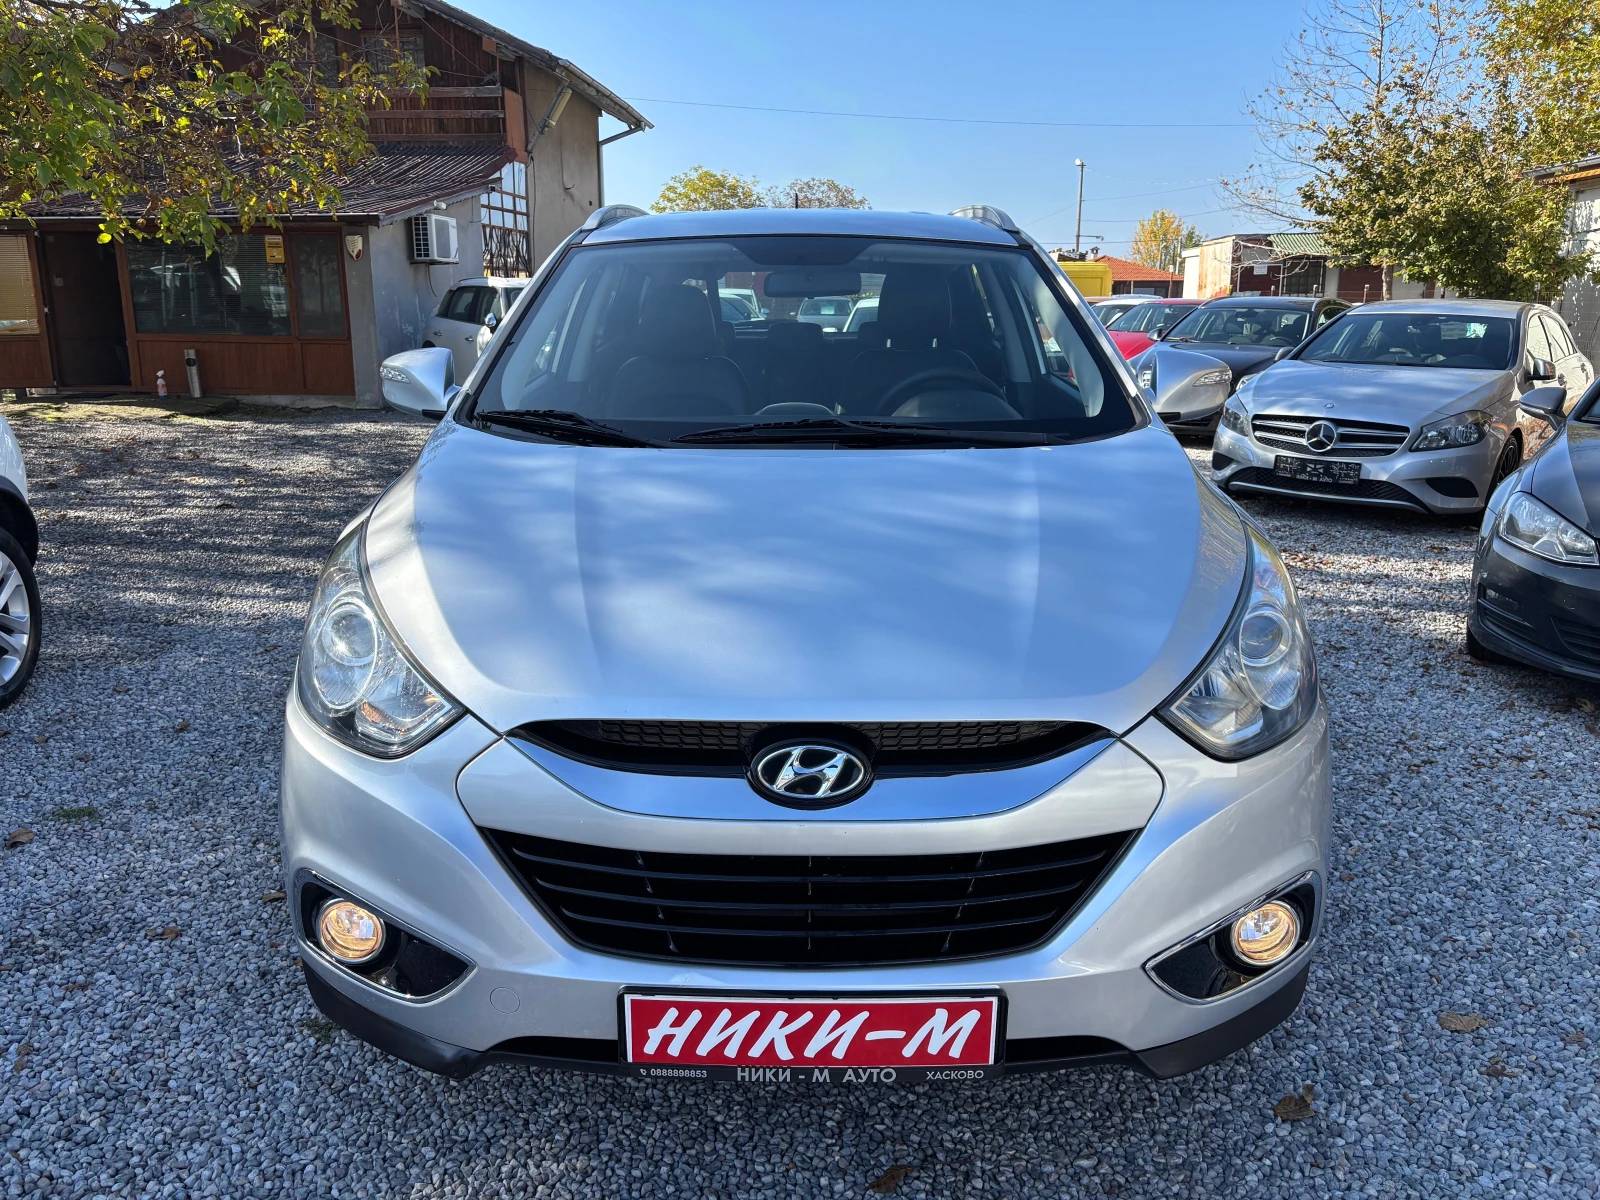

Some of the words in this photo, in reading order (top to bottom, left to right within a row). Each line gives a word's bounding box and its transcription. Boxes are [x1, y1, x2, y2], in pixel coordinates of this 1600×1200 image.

[643, 1007, 981, 1060] НИКИ-М
[650, 1068, 708, 1079] 0888898853
[737, 1068, 791, 1083] НИКИ
[812, 1068, 831, 1083] М
[842, 1068, 898, 1083] АУТО
[926, 1070, 985, 1080] ХАСКОВО
